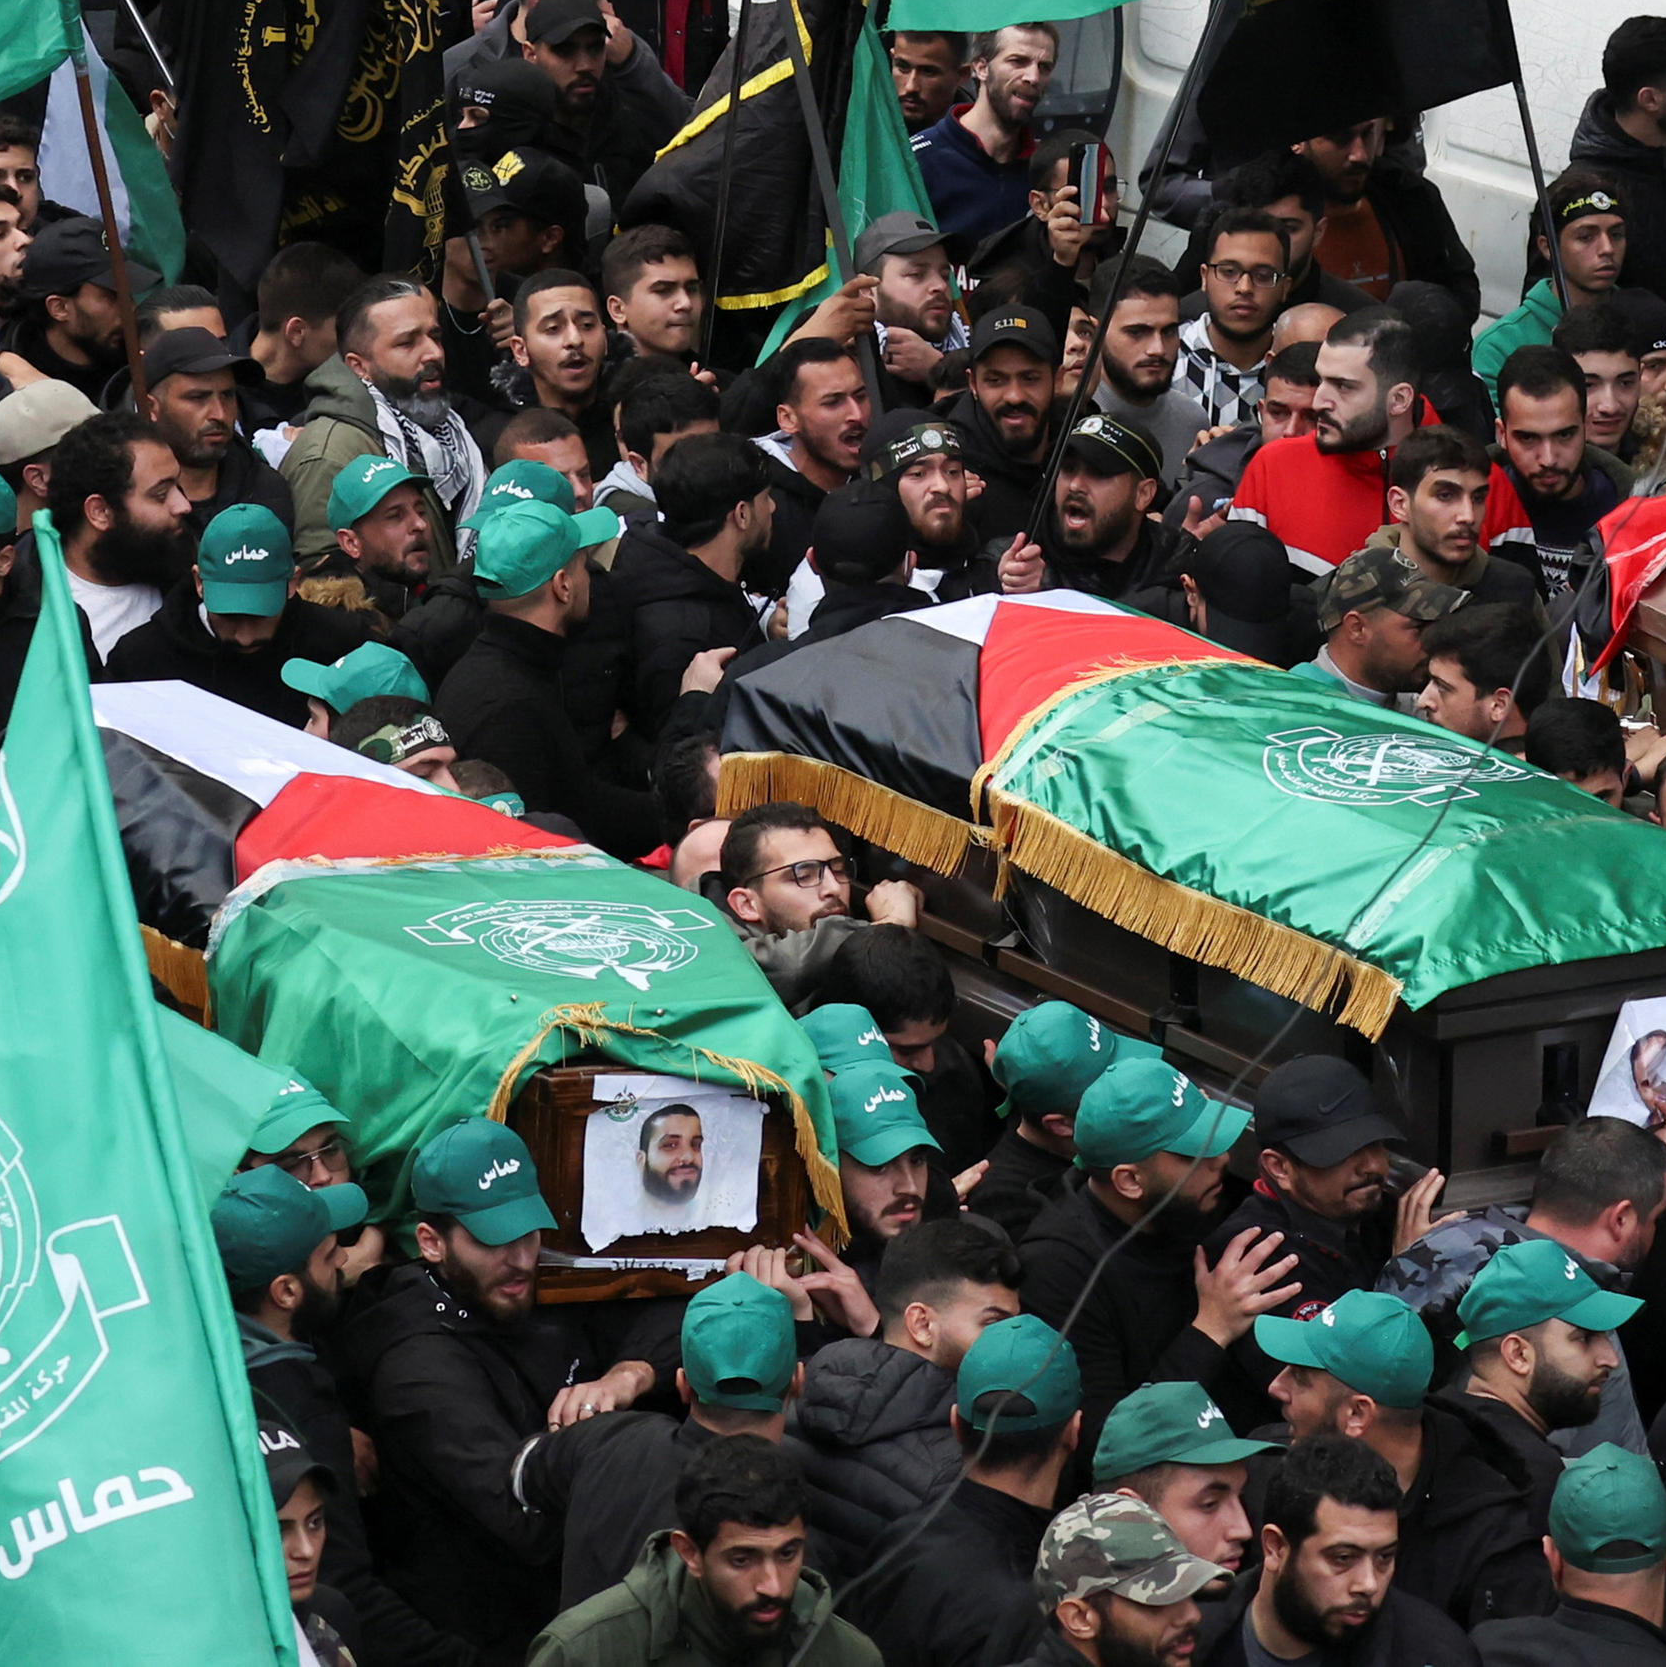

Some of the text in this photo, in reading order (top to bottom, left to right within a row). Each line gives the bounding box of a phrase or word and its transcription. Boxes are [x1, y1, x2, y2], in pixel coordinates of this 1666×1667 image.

[490, 478, 534, 499] حماس
[224, 544, 270, 565] حماس
[863, 1085, 908, 1114] حماس
[478, 1158, 521, 1190] حماس
[25, 1354, 71, 1400] حركة
